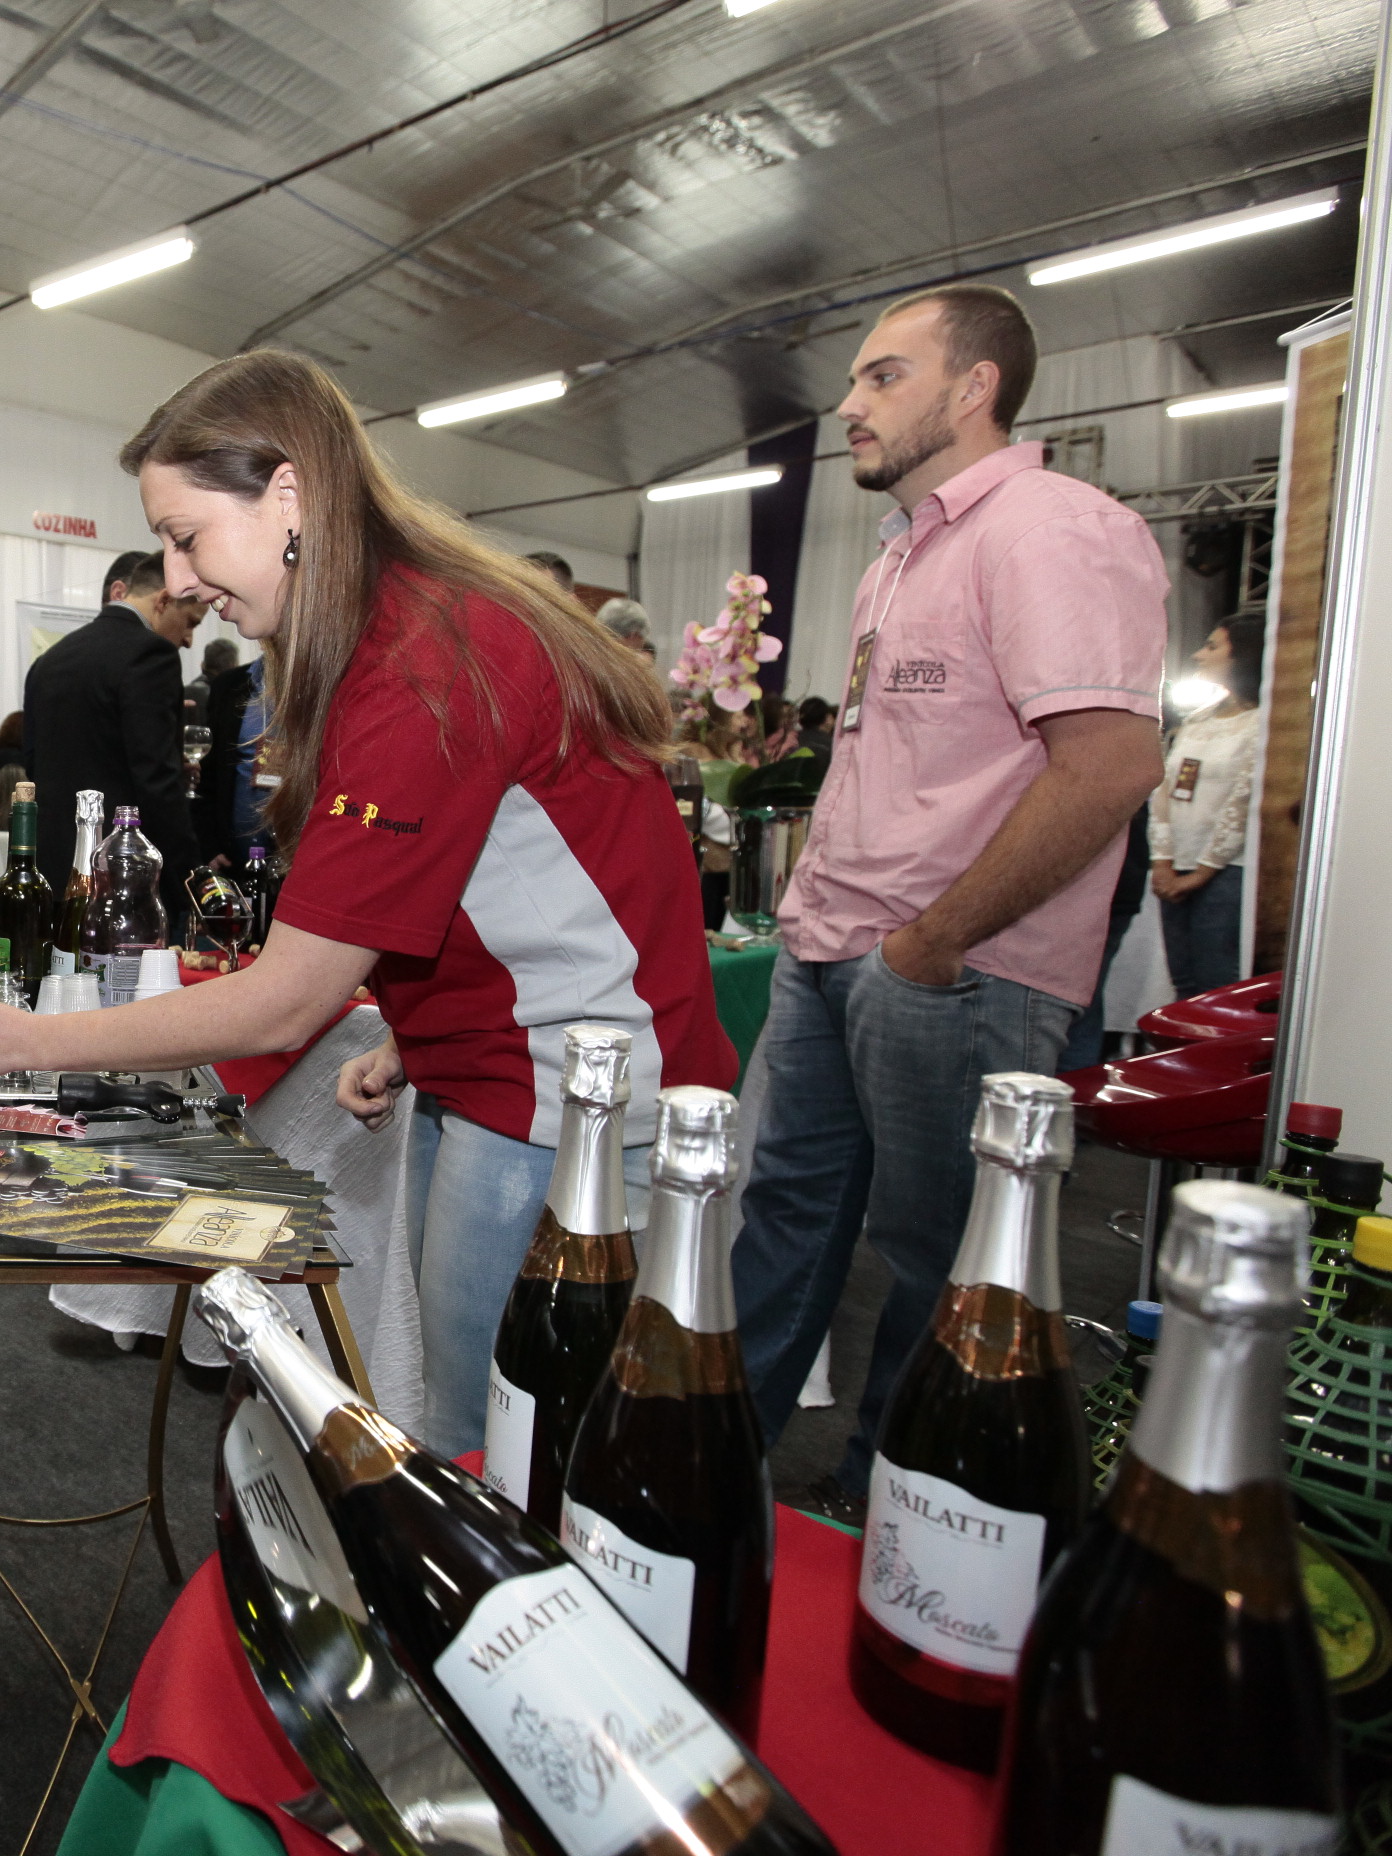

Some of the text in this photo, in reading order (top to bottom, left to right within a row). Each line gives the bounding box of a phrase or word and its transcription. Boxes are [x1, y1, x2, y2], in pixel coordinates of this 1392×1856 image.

[31, 510, 97, 539] COZINHA
[362, 803, 424, 837] Pasqual
[888, 1478, 1005, 1544] VAILATTI
[565, 1511, 654, 1586] VAILATTI
[468, 1588, 582, 1675] VAILATTI
